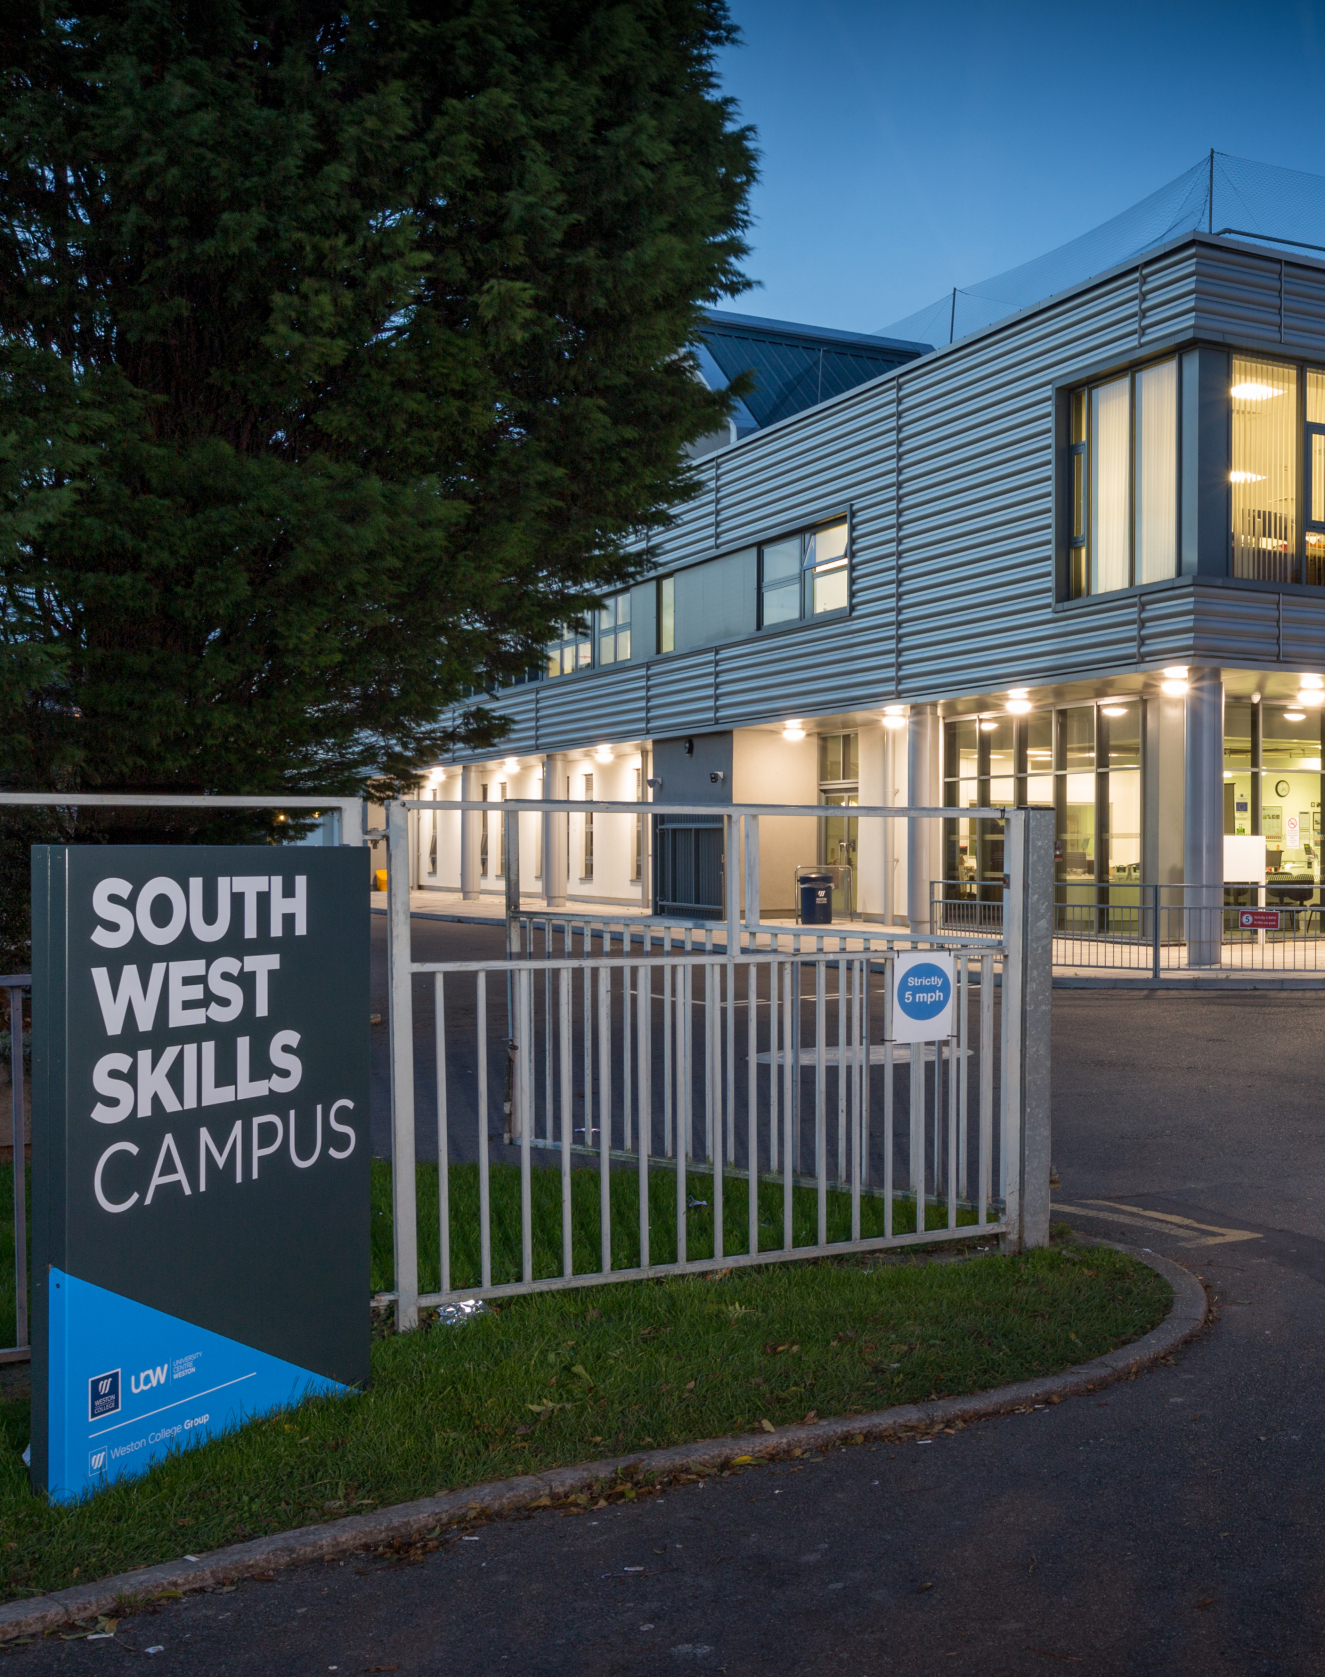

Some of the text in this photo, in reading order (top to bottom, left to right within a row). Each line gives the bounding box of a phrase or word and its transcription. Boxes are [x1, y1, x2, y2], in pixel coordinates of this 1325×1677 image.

[90, 875, 307, 949] SOUTH
[908, 976, 943, 987] Strictly
[90, 953, 280, 1036] WEST
[905, 990, 943, 1004] 5 mph
[90, 1029, 303, 1124] SKILLS
[94, 1099, 356, 1213] CAMPUS
[173, 1351, 203, 1367] UNIVERSITY
[173, 1360, 194, 1374] CENTRE
[131, 1363, 168, 1394] UCW
[173, 1367, 196, 1380] WESTON
[94, 1394, 116, 1407] WESTON
[94, 1401, 115, 1414] COLLEGE
[110, 1413, 210, 1460] Weston College Group
